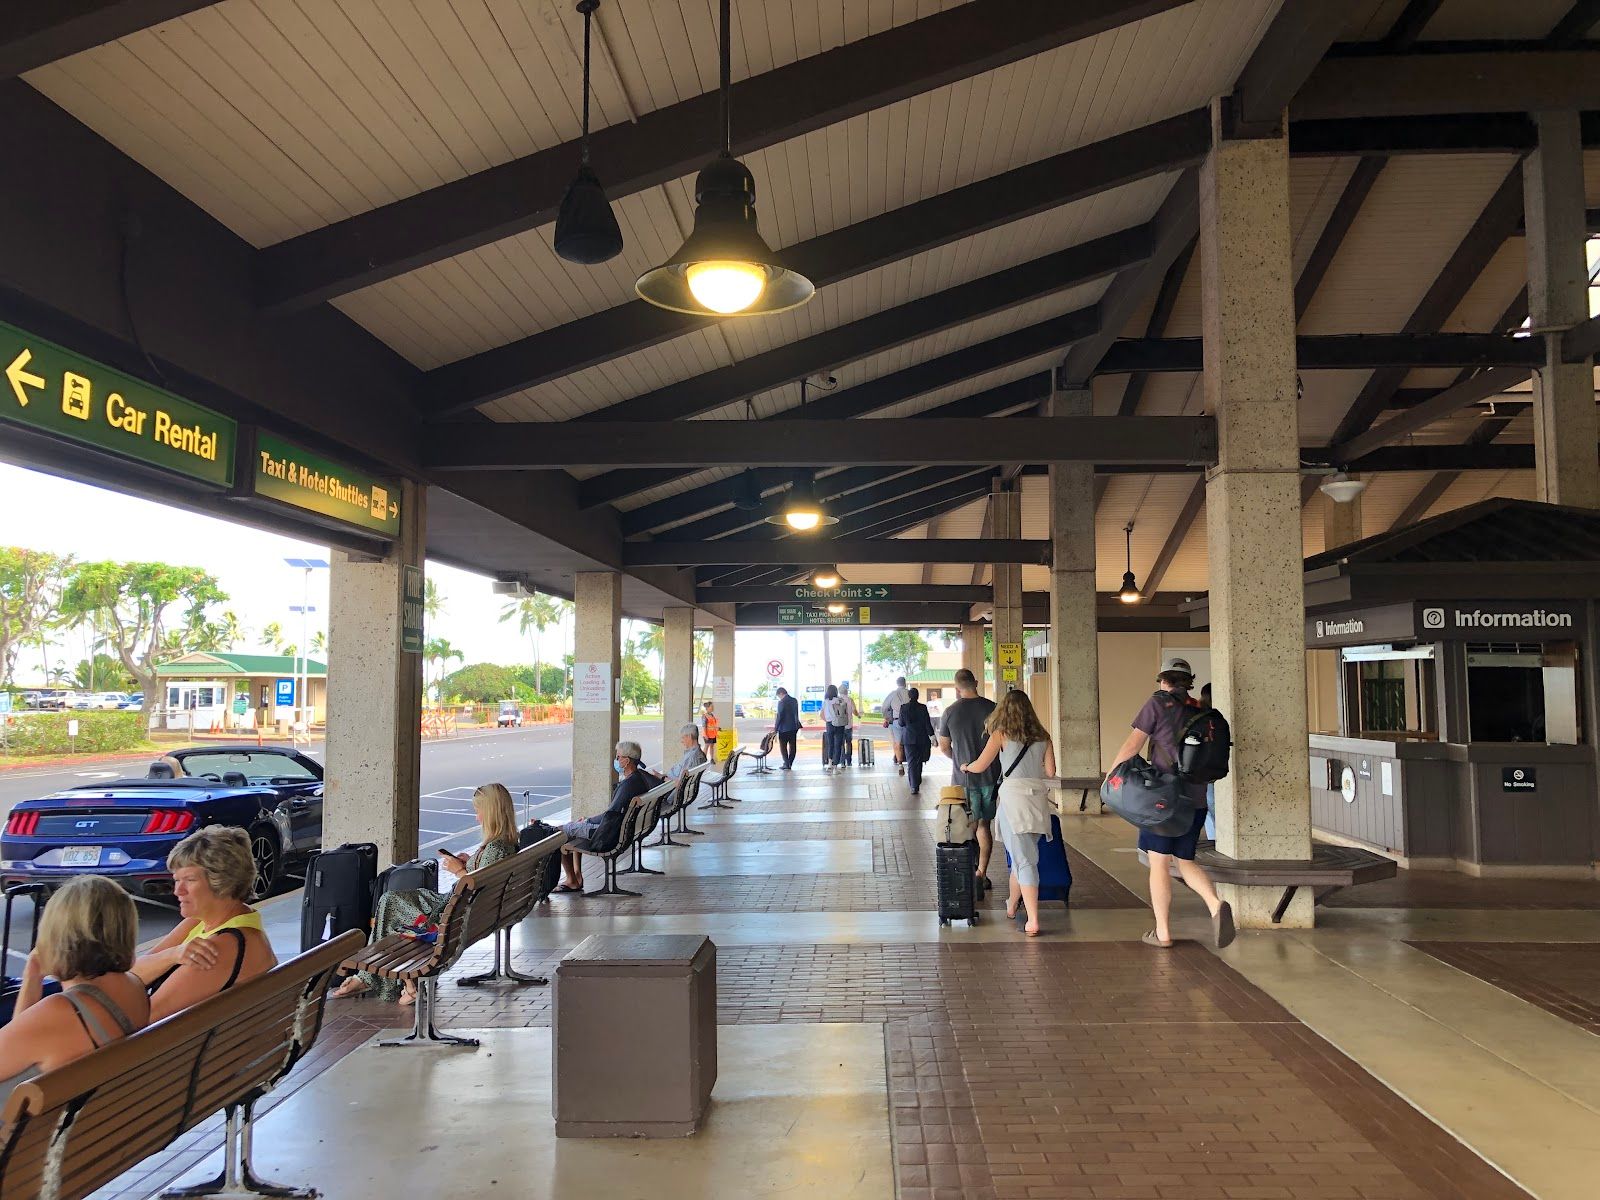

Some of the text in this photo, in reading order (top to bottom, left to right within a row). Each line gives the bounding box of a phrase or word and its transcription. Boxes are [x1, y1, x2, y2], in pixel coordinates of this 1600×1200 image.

[106, 393, 217, 461] Car Rental
[261, 451, 369, 509] Taxi & Hotel Shuttles
[795, 588, 872, 598] Check Point 3
[1325, 618, 1364, 636] Information
[1455, 609, 1572, 627] Information
[282, 684, 288, 692] P
[75, 820, 100, 828] GT
